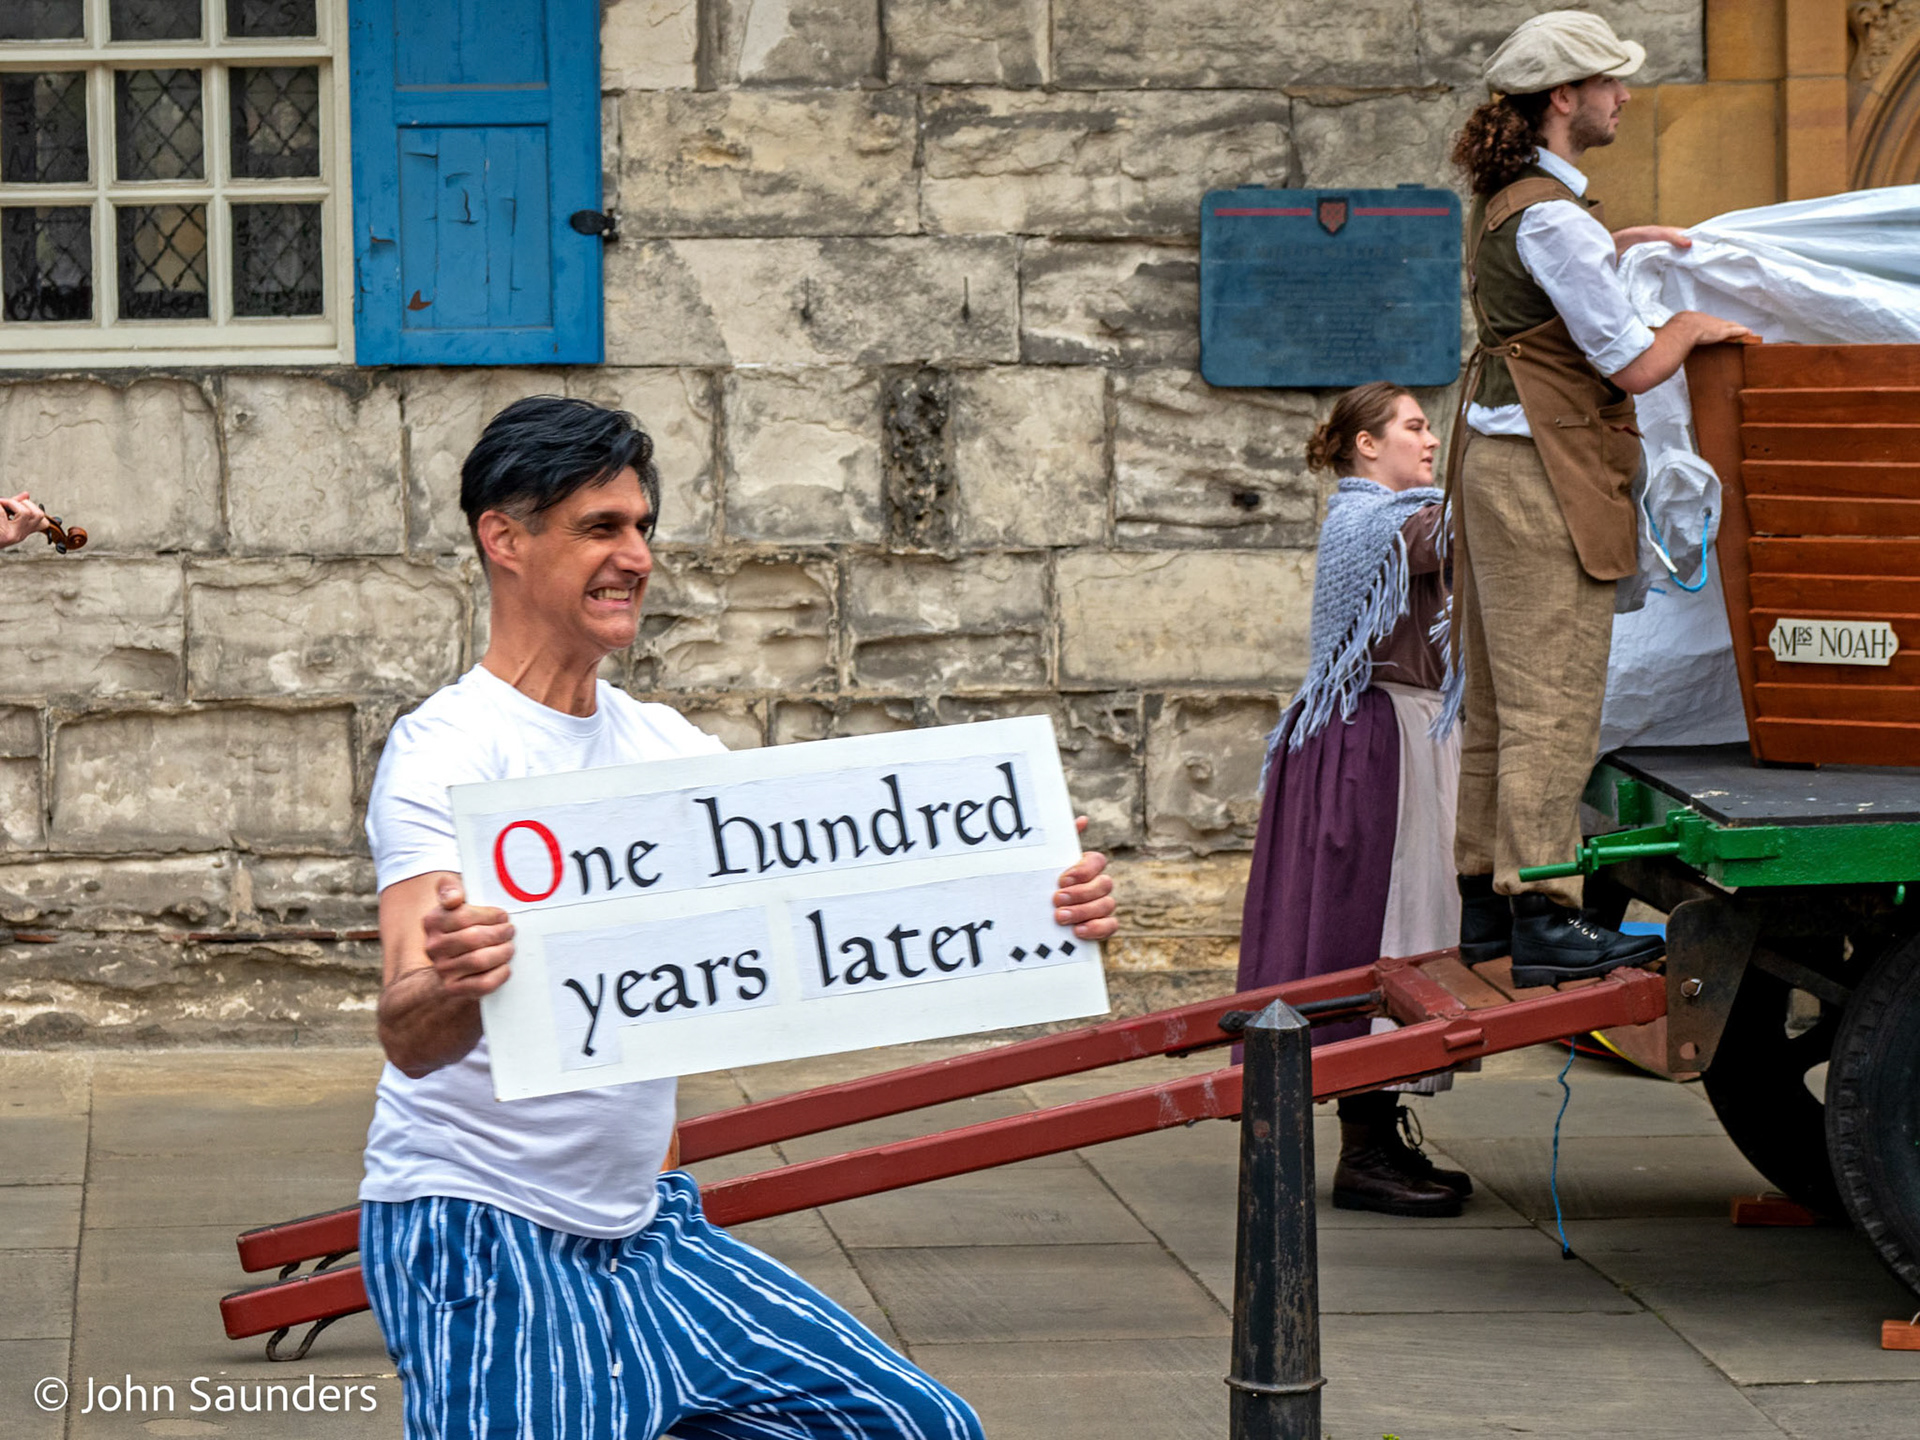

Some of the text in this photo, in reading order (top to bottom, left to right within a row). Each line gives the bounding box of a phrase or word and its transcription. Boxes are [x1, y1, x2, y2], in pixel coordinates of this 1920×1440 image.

[1819, 627, 1887, 658] NOAH
[494, 762, 1031, 902] One hundred
[564, 908, 1077, 1056] years later...
